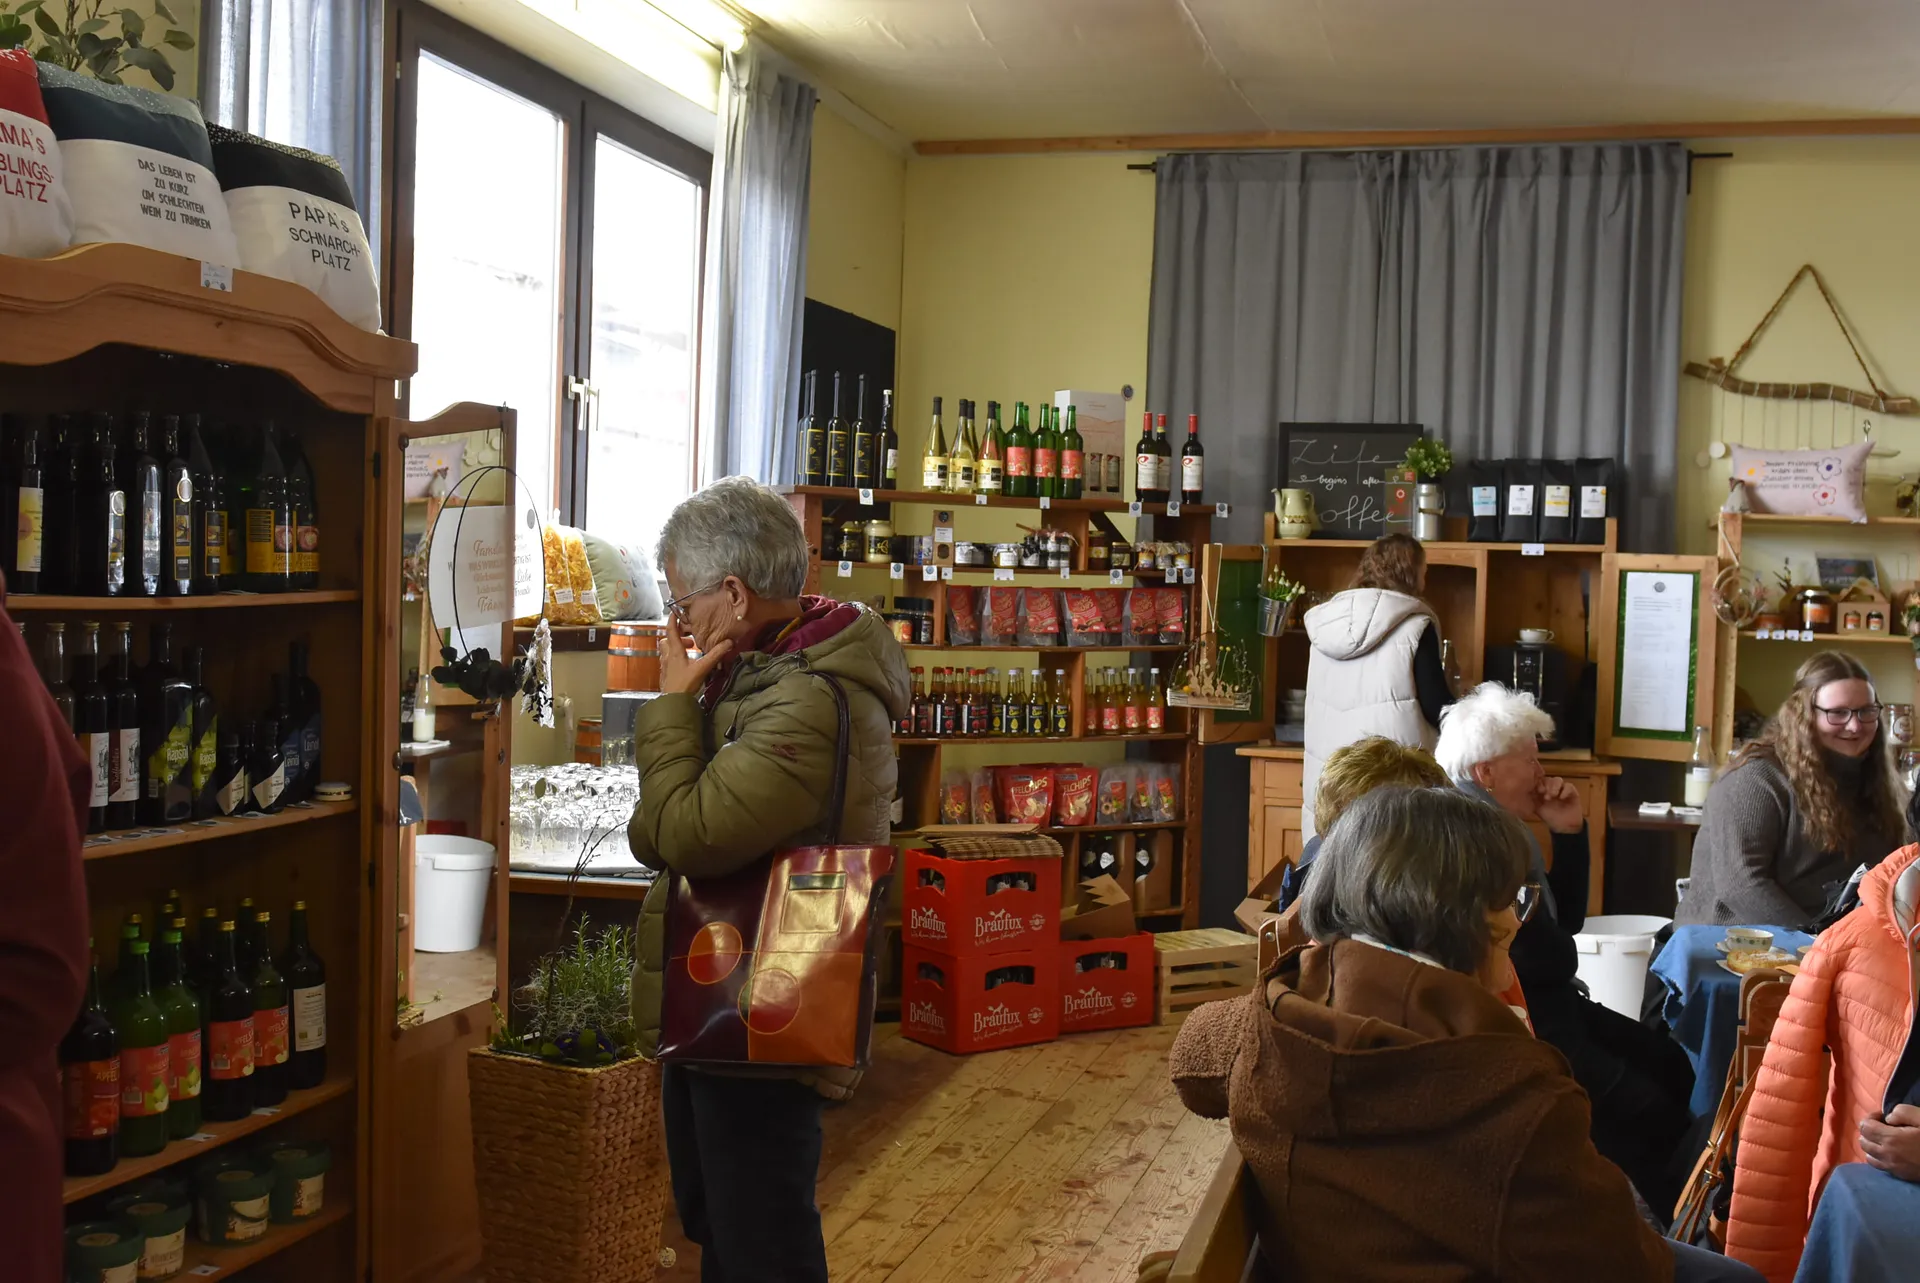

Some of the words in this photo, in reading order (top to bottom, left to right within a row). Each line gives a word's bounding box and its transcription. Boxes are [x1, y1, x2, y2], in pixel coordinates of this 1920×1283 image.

[0, 122, 46, 155] MA's
[138, 158, 155, 172] DAS
[158, 164, 183, 180] LEBEN
[185, 172, 196, 183] IST
[0, 174, 48, 203] LATZ
[154, 177, 166, 189] ZU
[168, 181, 189, 196] KURZ
[142, 189, 155, 201] UM
[159, 194, 205, 214] SCHLECHTEN
[140, 203, 161, 218] WEIN
[165, 210, 176, 221] ZU
[180, 213, 211, 230] TRINKEN
[289, 227, 360, 257] SCHNARCH-
[312, 249, 351, 272] PLATZ
[1318, 475, 1357, 490] begins
[1362, 477, 1384, 488] after
[1319, 495, 1411, 530] offee
[167, 746, 188, 762] Rapsöl
[911, 908, 946, 933] Braufux
[974, 913, 1022, 938] Braufux
[910, 1002, 945, 1028] Braufux
[1064, 991, 1114, 1015] Braufux
[973, 1007, 1021, 1033] Braufux
